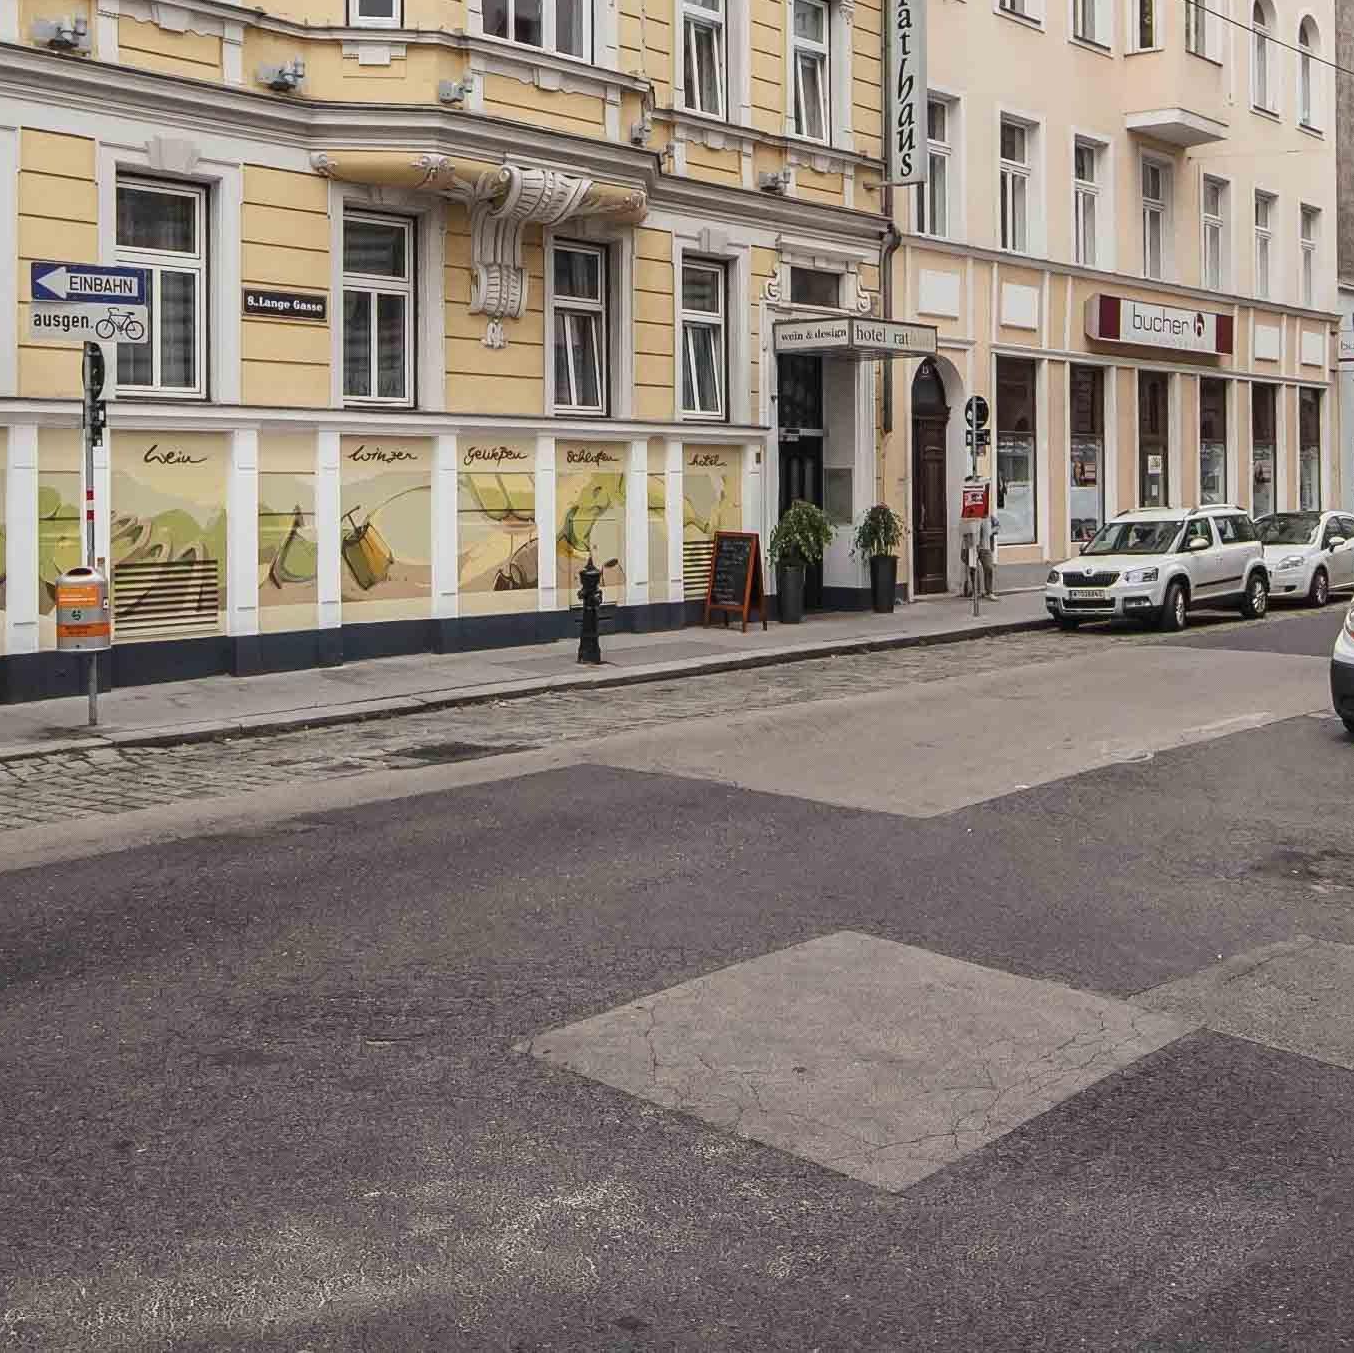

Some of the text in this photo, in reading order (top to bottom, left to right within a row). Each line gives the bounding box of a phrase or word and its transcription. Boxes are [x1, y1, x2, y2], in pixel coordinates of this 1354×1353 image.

[69, 275, 133, 294] EINBAHN
[259, 296, 290, 310] Lange
[293, 300, 323, 312] Gasse
[33, 313, 94, 332] ausgen.
[1132, 303, 1188, 335] bucher
[781, 332, 803, 341] wein
[814, 327, 847, 338] design
[856, 325, 887, 343] hotel
